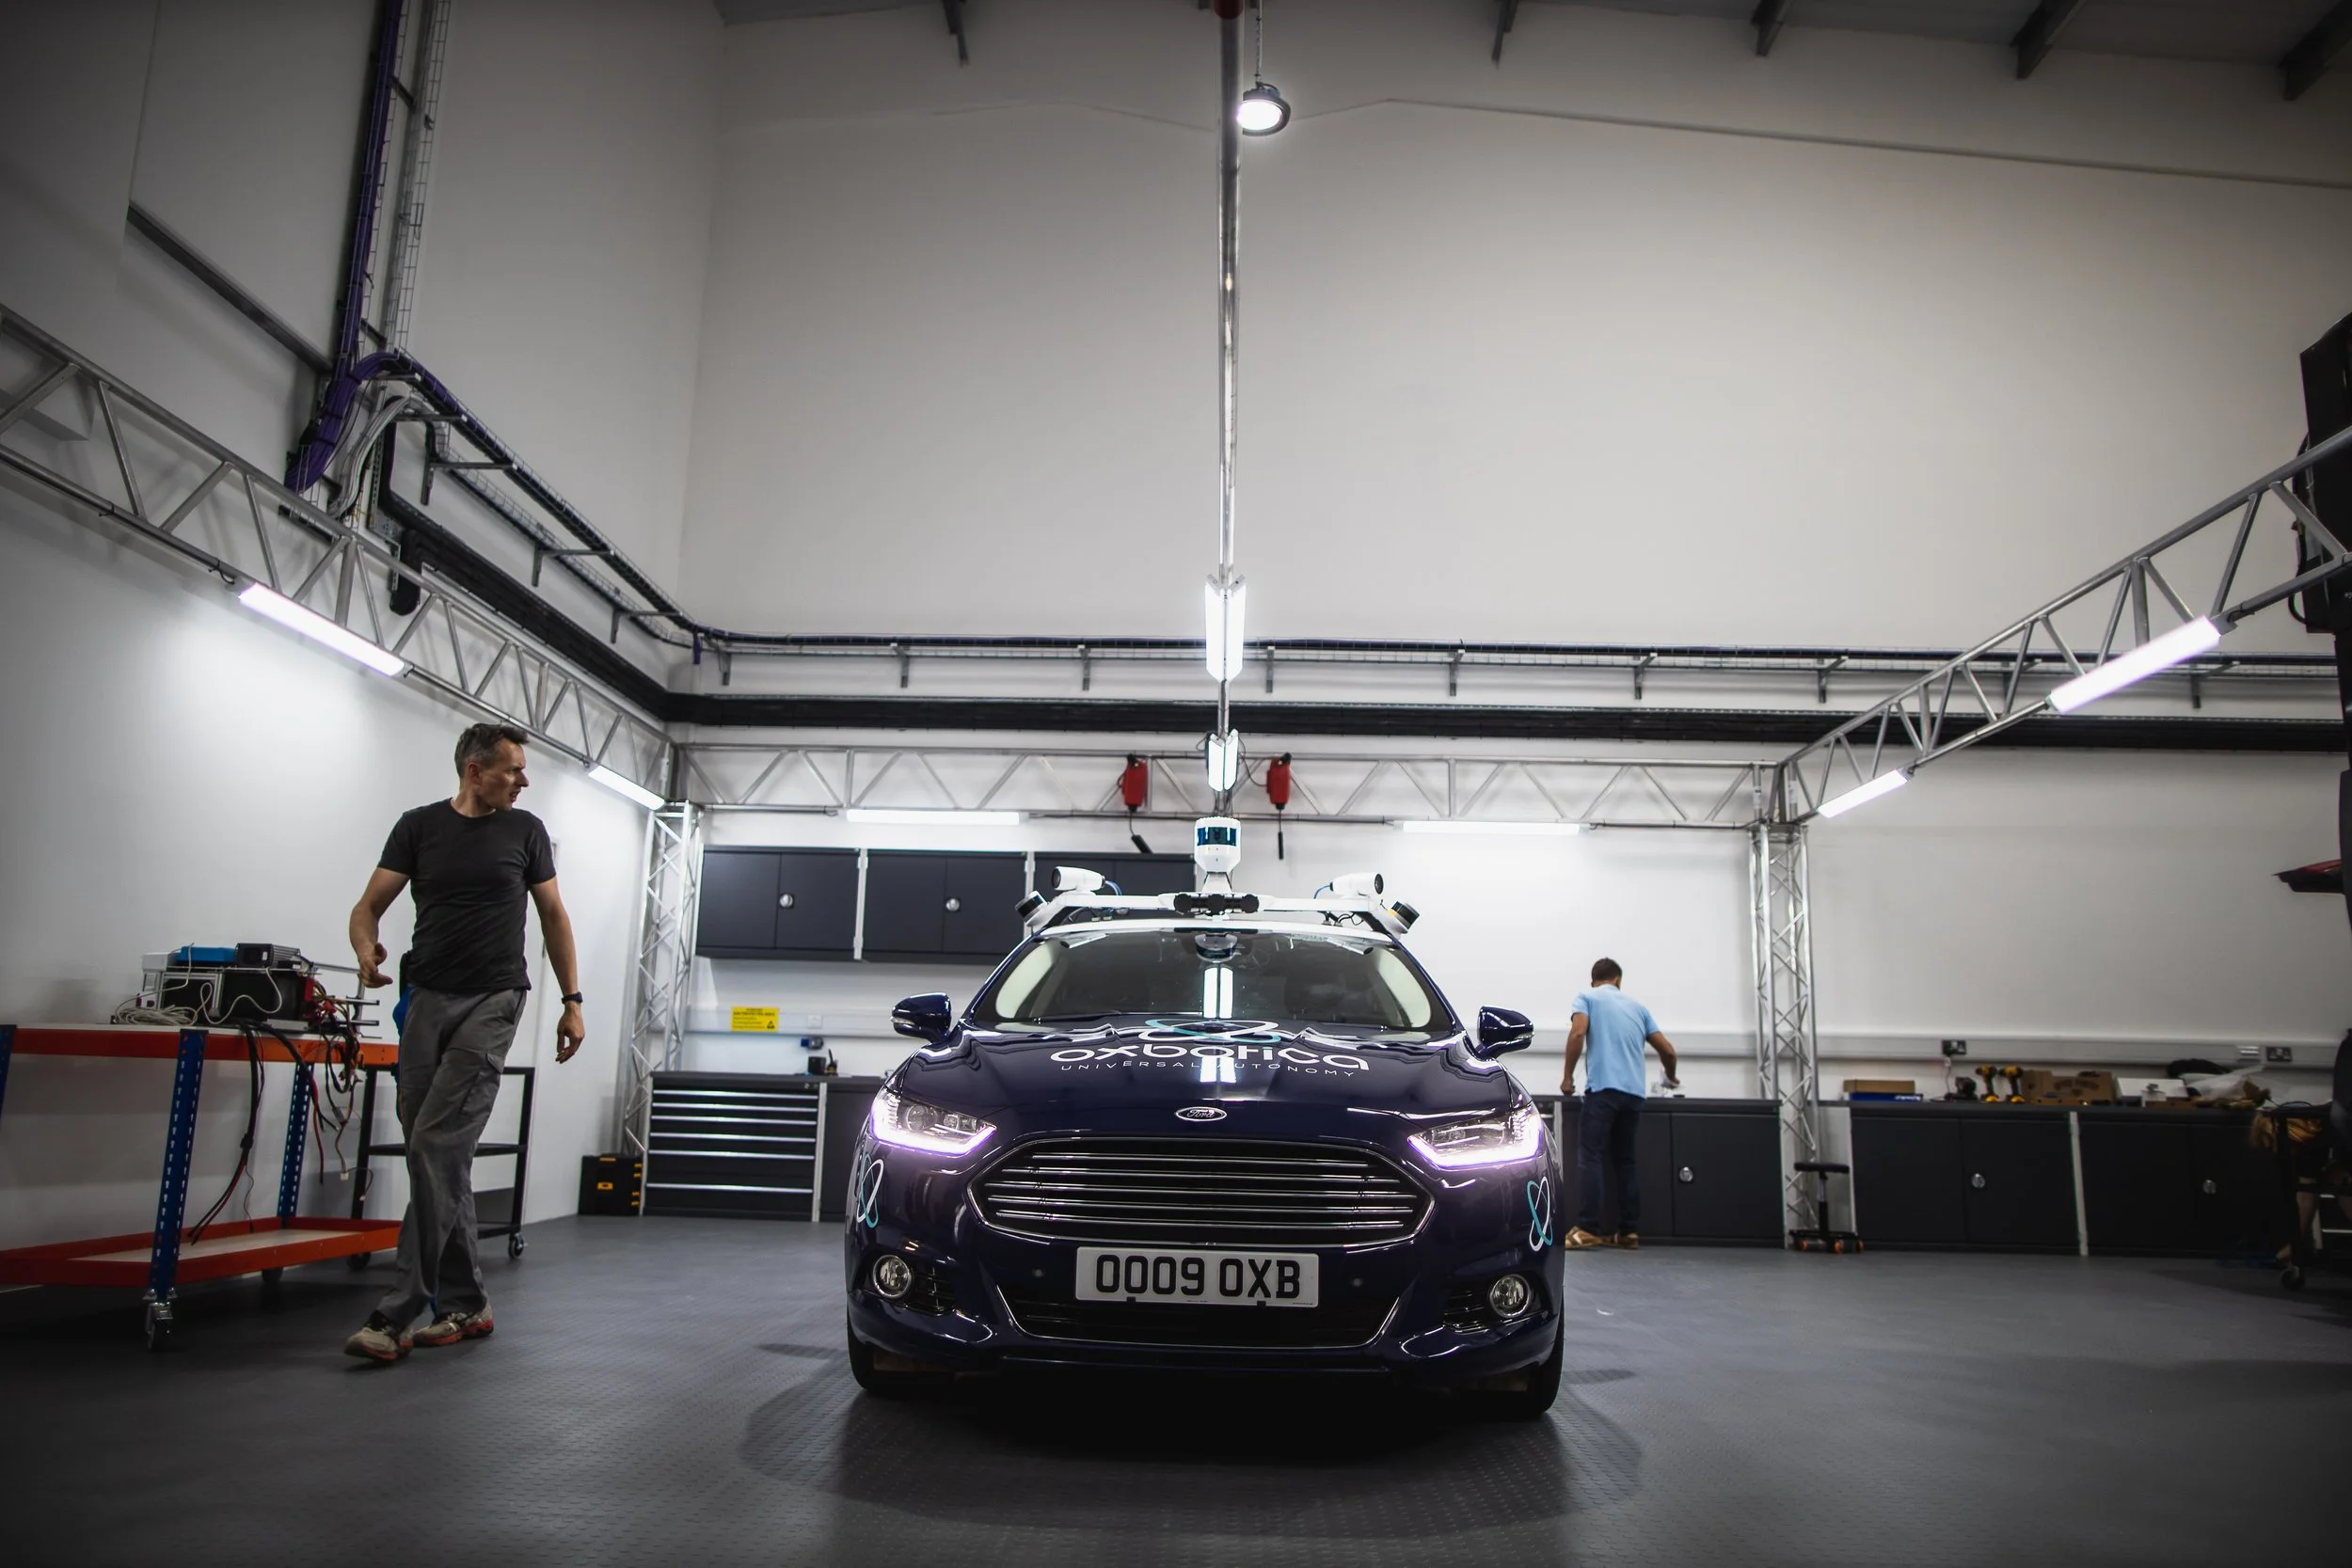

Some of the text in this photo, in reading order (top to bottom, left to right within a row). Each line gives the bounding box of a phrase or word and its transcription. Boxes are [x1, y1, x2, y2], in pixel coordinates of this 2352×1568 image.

[1050, 1044, 1369, 1070] oxbotica
[1061, 1061, 1355, 1077] UNIVERSAL UTONOMY
[1219, 1258, 1300, 1299] OXB
